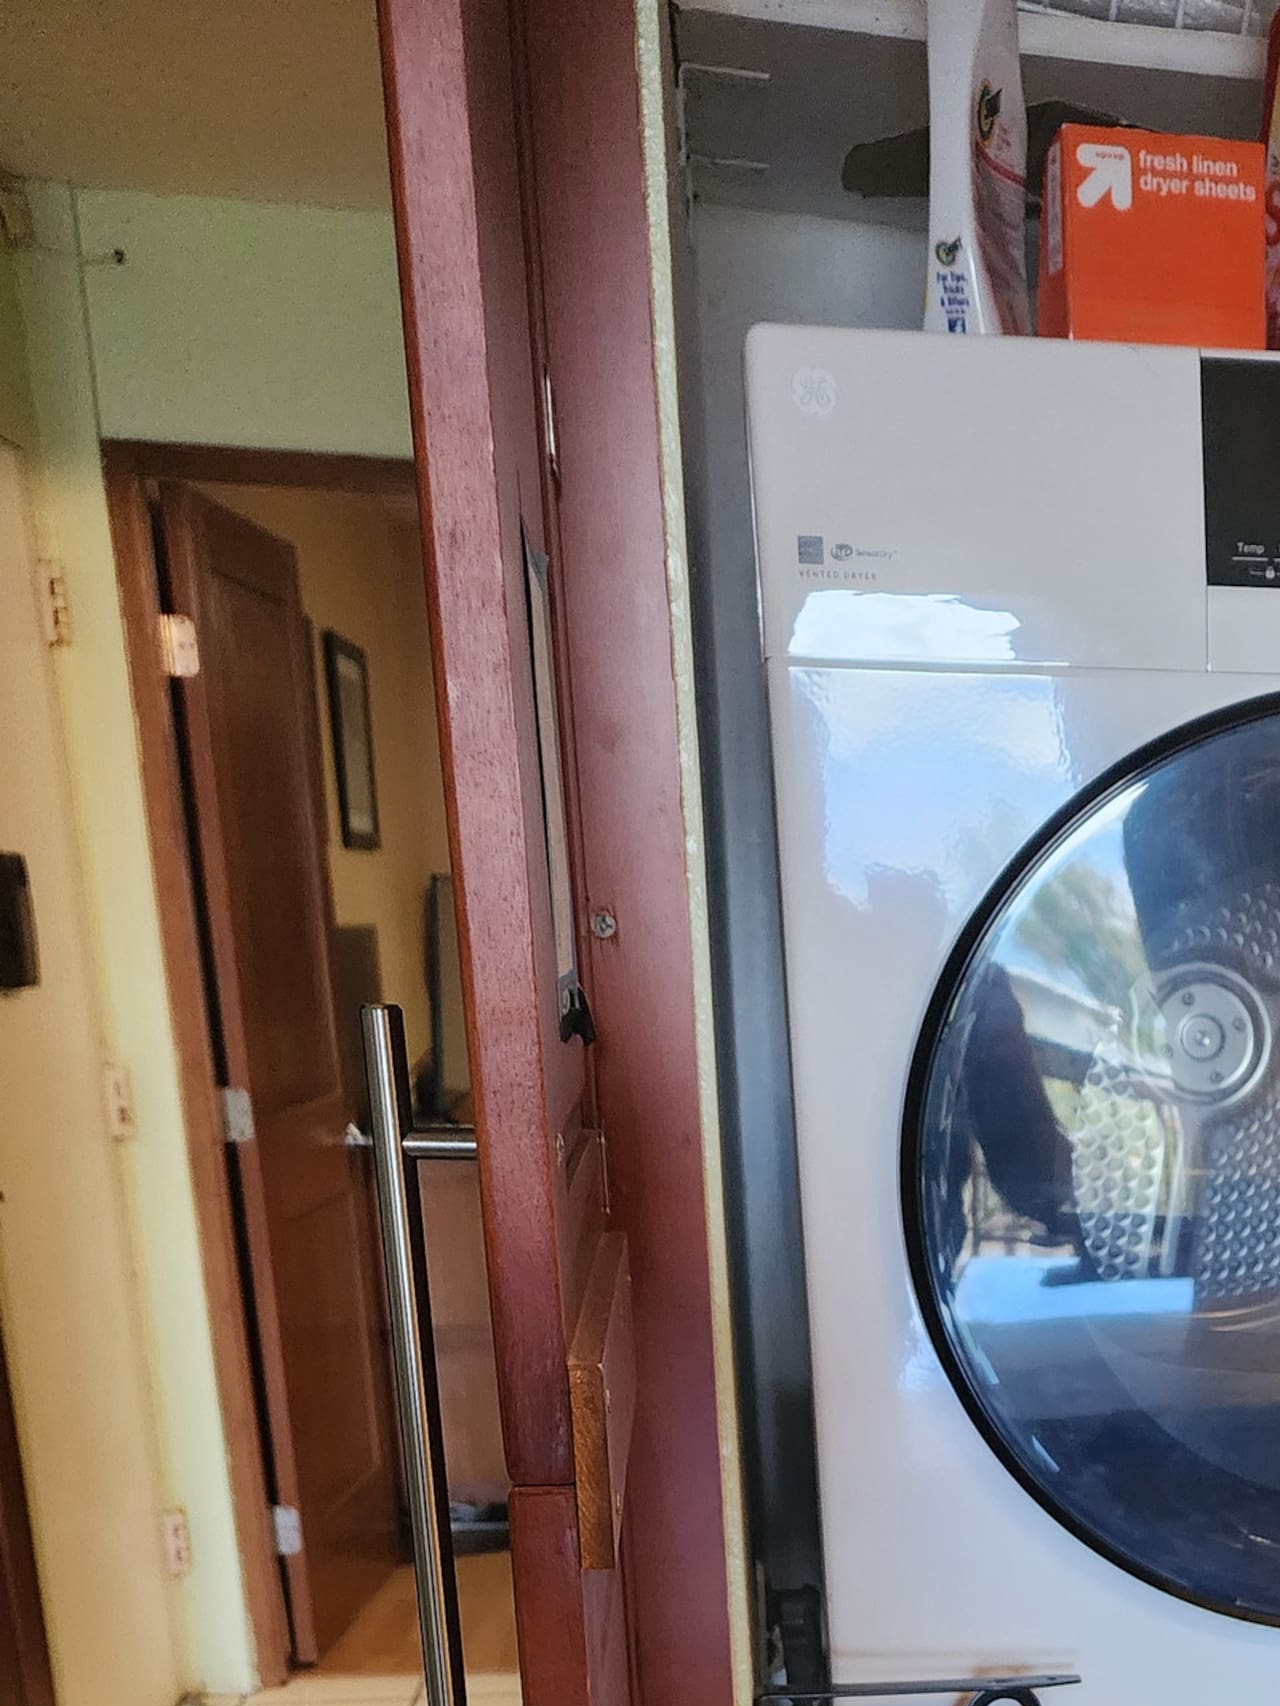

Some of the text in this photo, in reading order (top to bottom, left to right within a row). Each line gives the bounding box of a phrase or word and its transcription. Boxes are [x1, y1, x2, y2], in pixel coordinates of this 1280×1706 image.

[1138, 149, 1238, 178] fresh linen
[1140, 171, 1256, 202] dryer sheets
